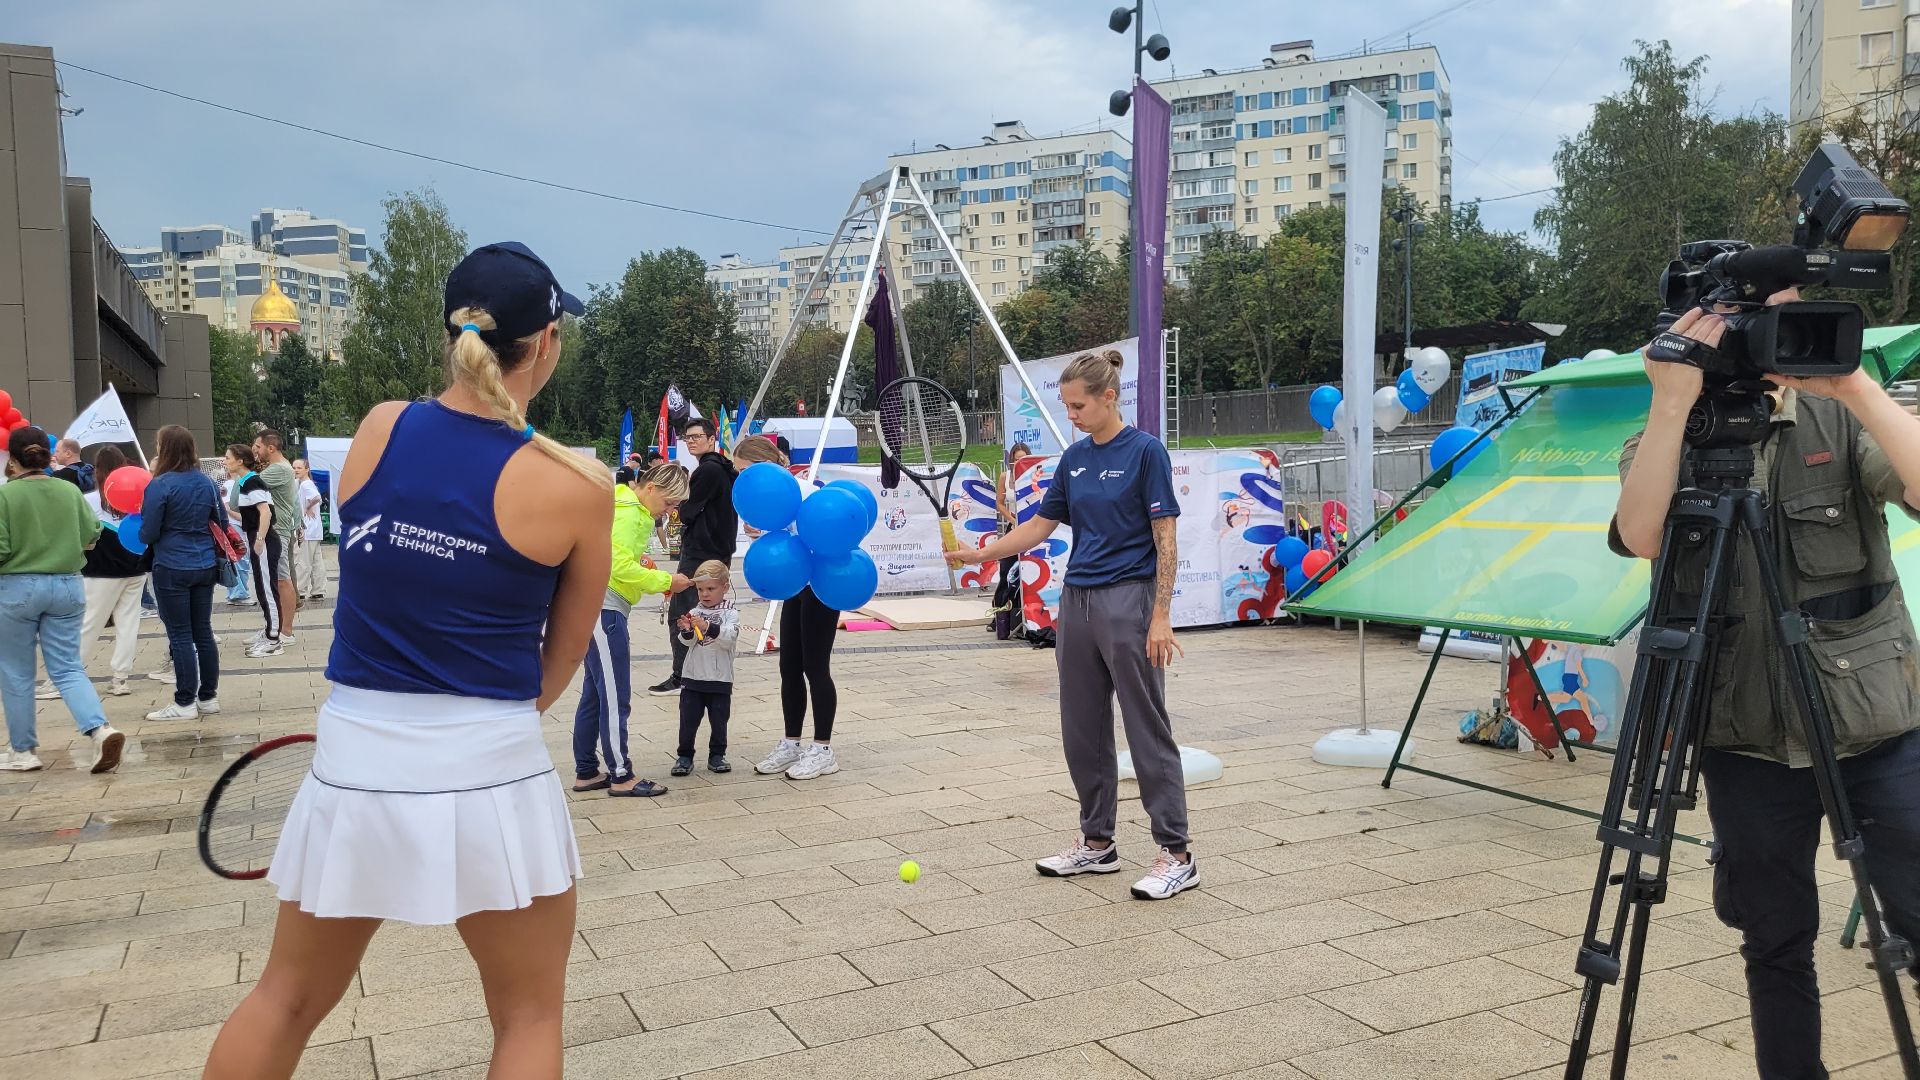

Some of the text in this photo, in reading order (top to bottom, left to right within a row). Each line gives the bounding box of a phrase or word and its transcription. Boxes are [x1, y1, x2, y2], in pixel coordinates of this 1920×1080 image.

[1655, 339, 1685, 351] Canon
[1510, 447, 1599, 466] Nothing
[389, 533, 455, 561] ТЕННИСА
[393, 520, 488, 556] ТЕРРИТОРИЯ
